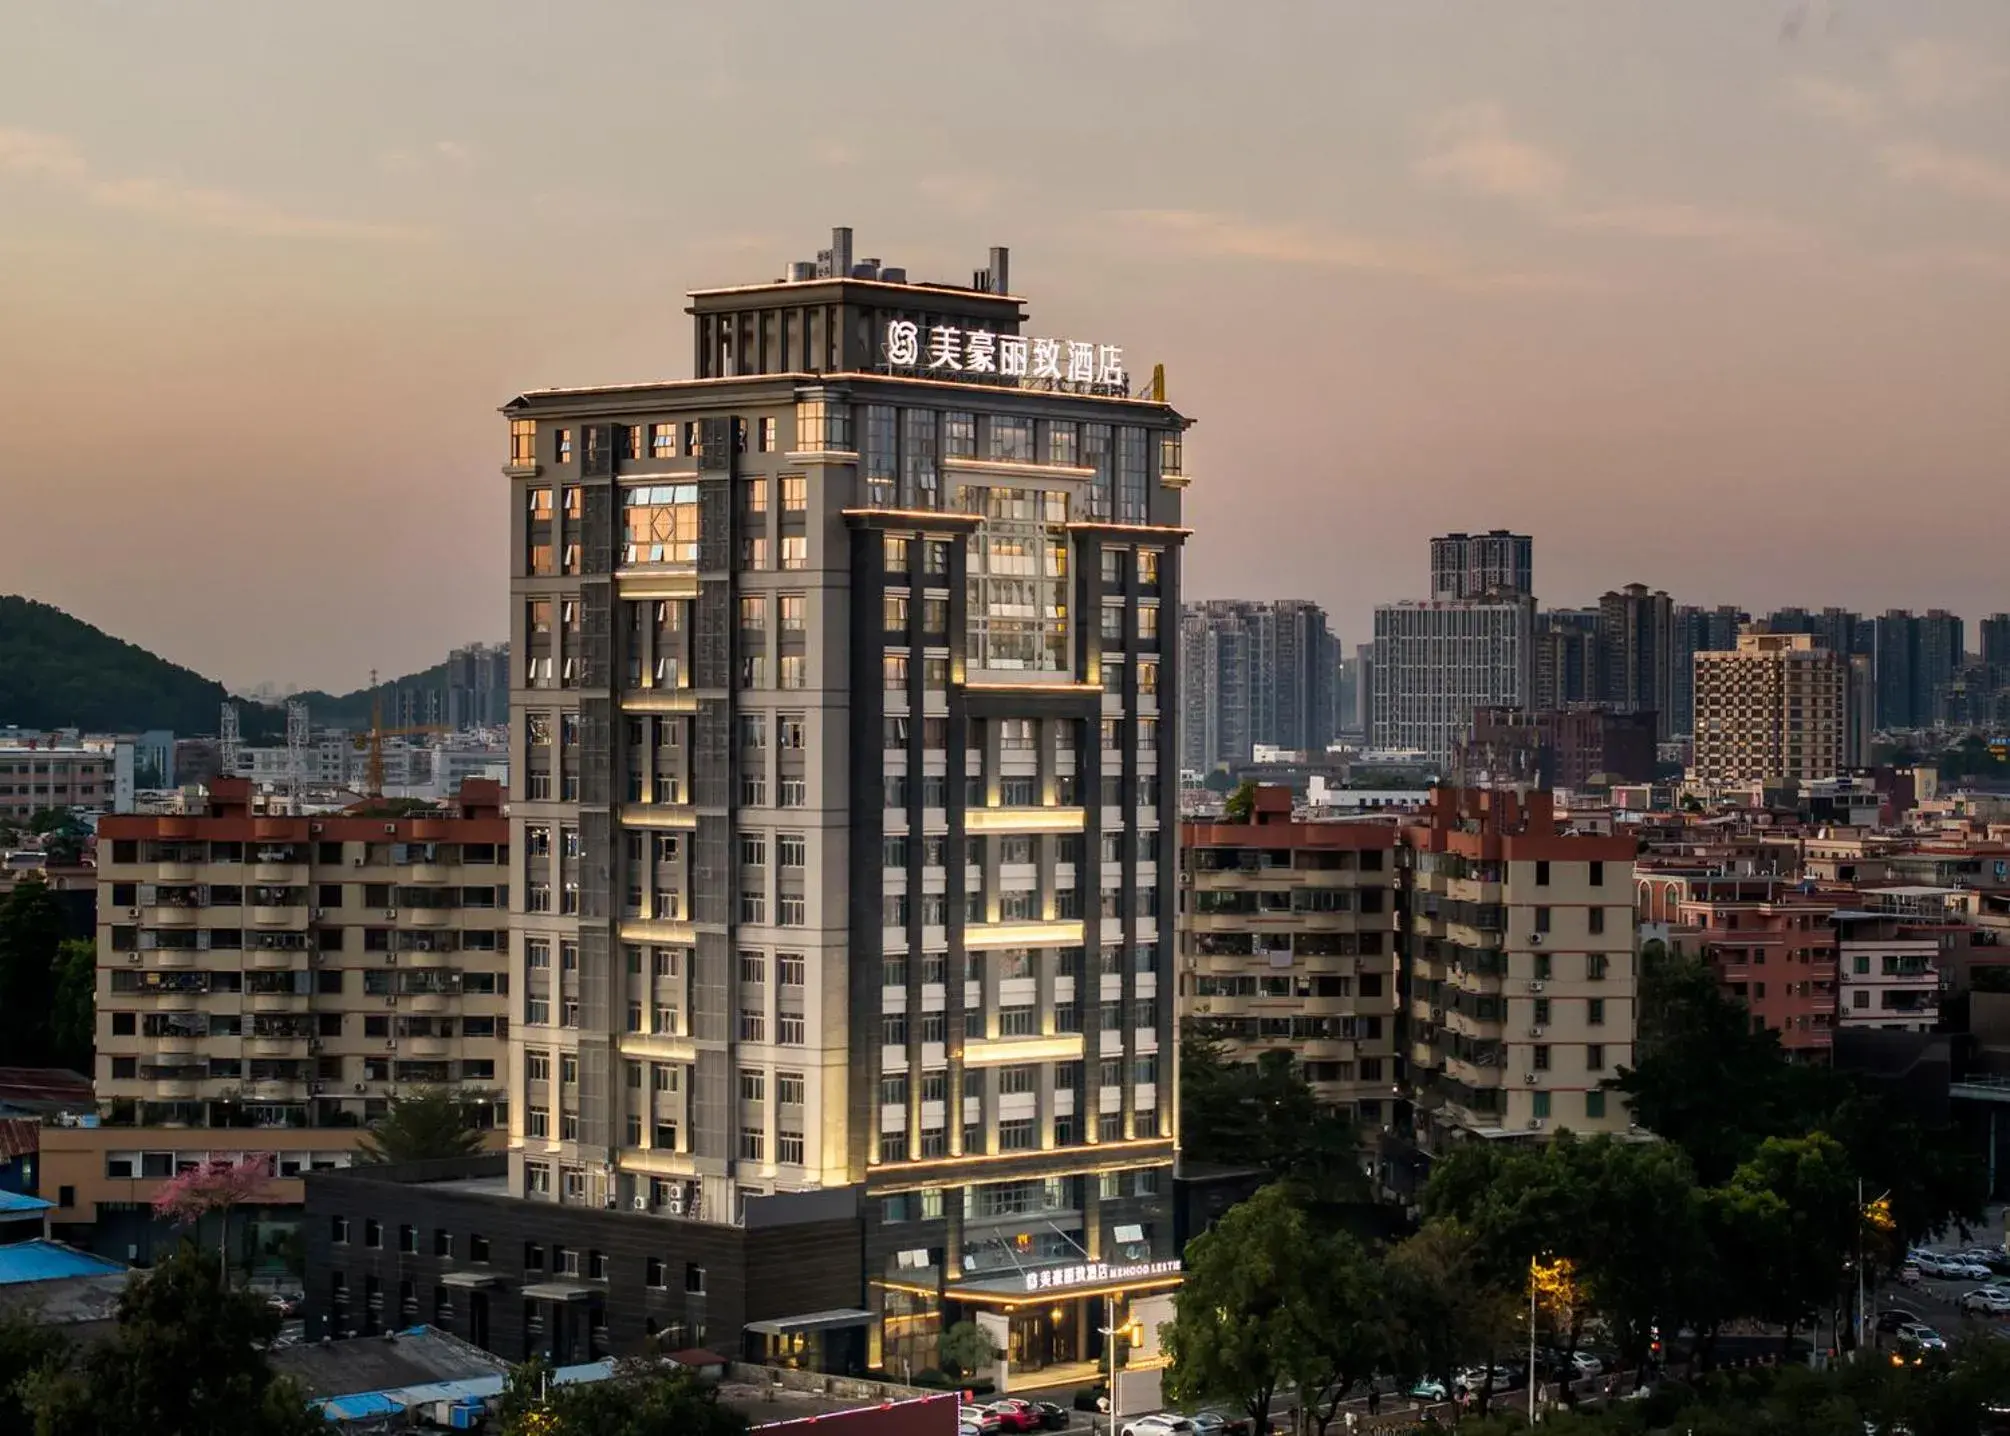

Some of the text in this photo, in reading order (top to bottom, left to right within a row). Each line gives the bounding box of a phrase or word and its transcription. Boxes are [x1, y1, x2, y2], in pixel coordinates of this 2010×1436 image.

[929, 326, 1123, 385] 美豪丽致酒店
